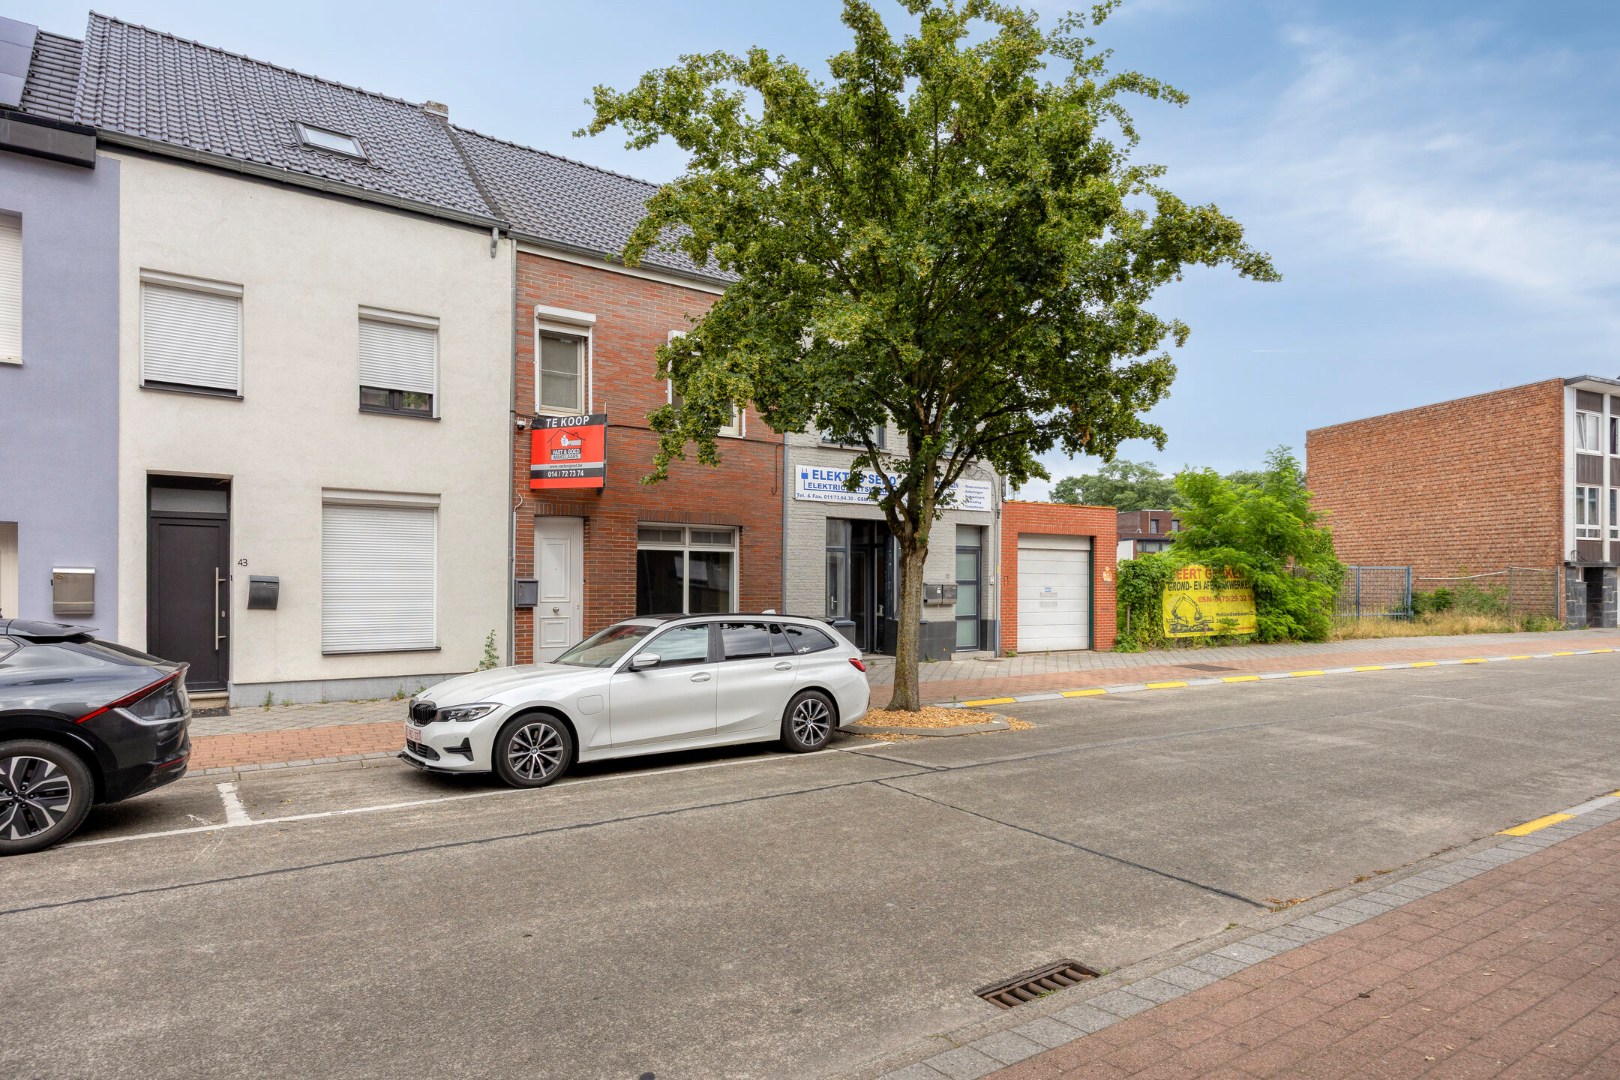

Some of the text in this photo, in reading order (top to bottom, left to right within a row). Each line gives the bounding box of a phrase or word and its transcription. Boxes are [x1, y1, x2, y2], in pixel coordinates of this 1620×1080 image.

[546, 416, 590, 428] TE KOOP
[868, 474, 896, 486] SEO
[1174, 568, 1202, 580] EERT
[1194, 580, 1202, 590] EN
